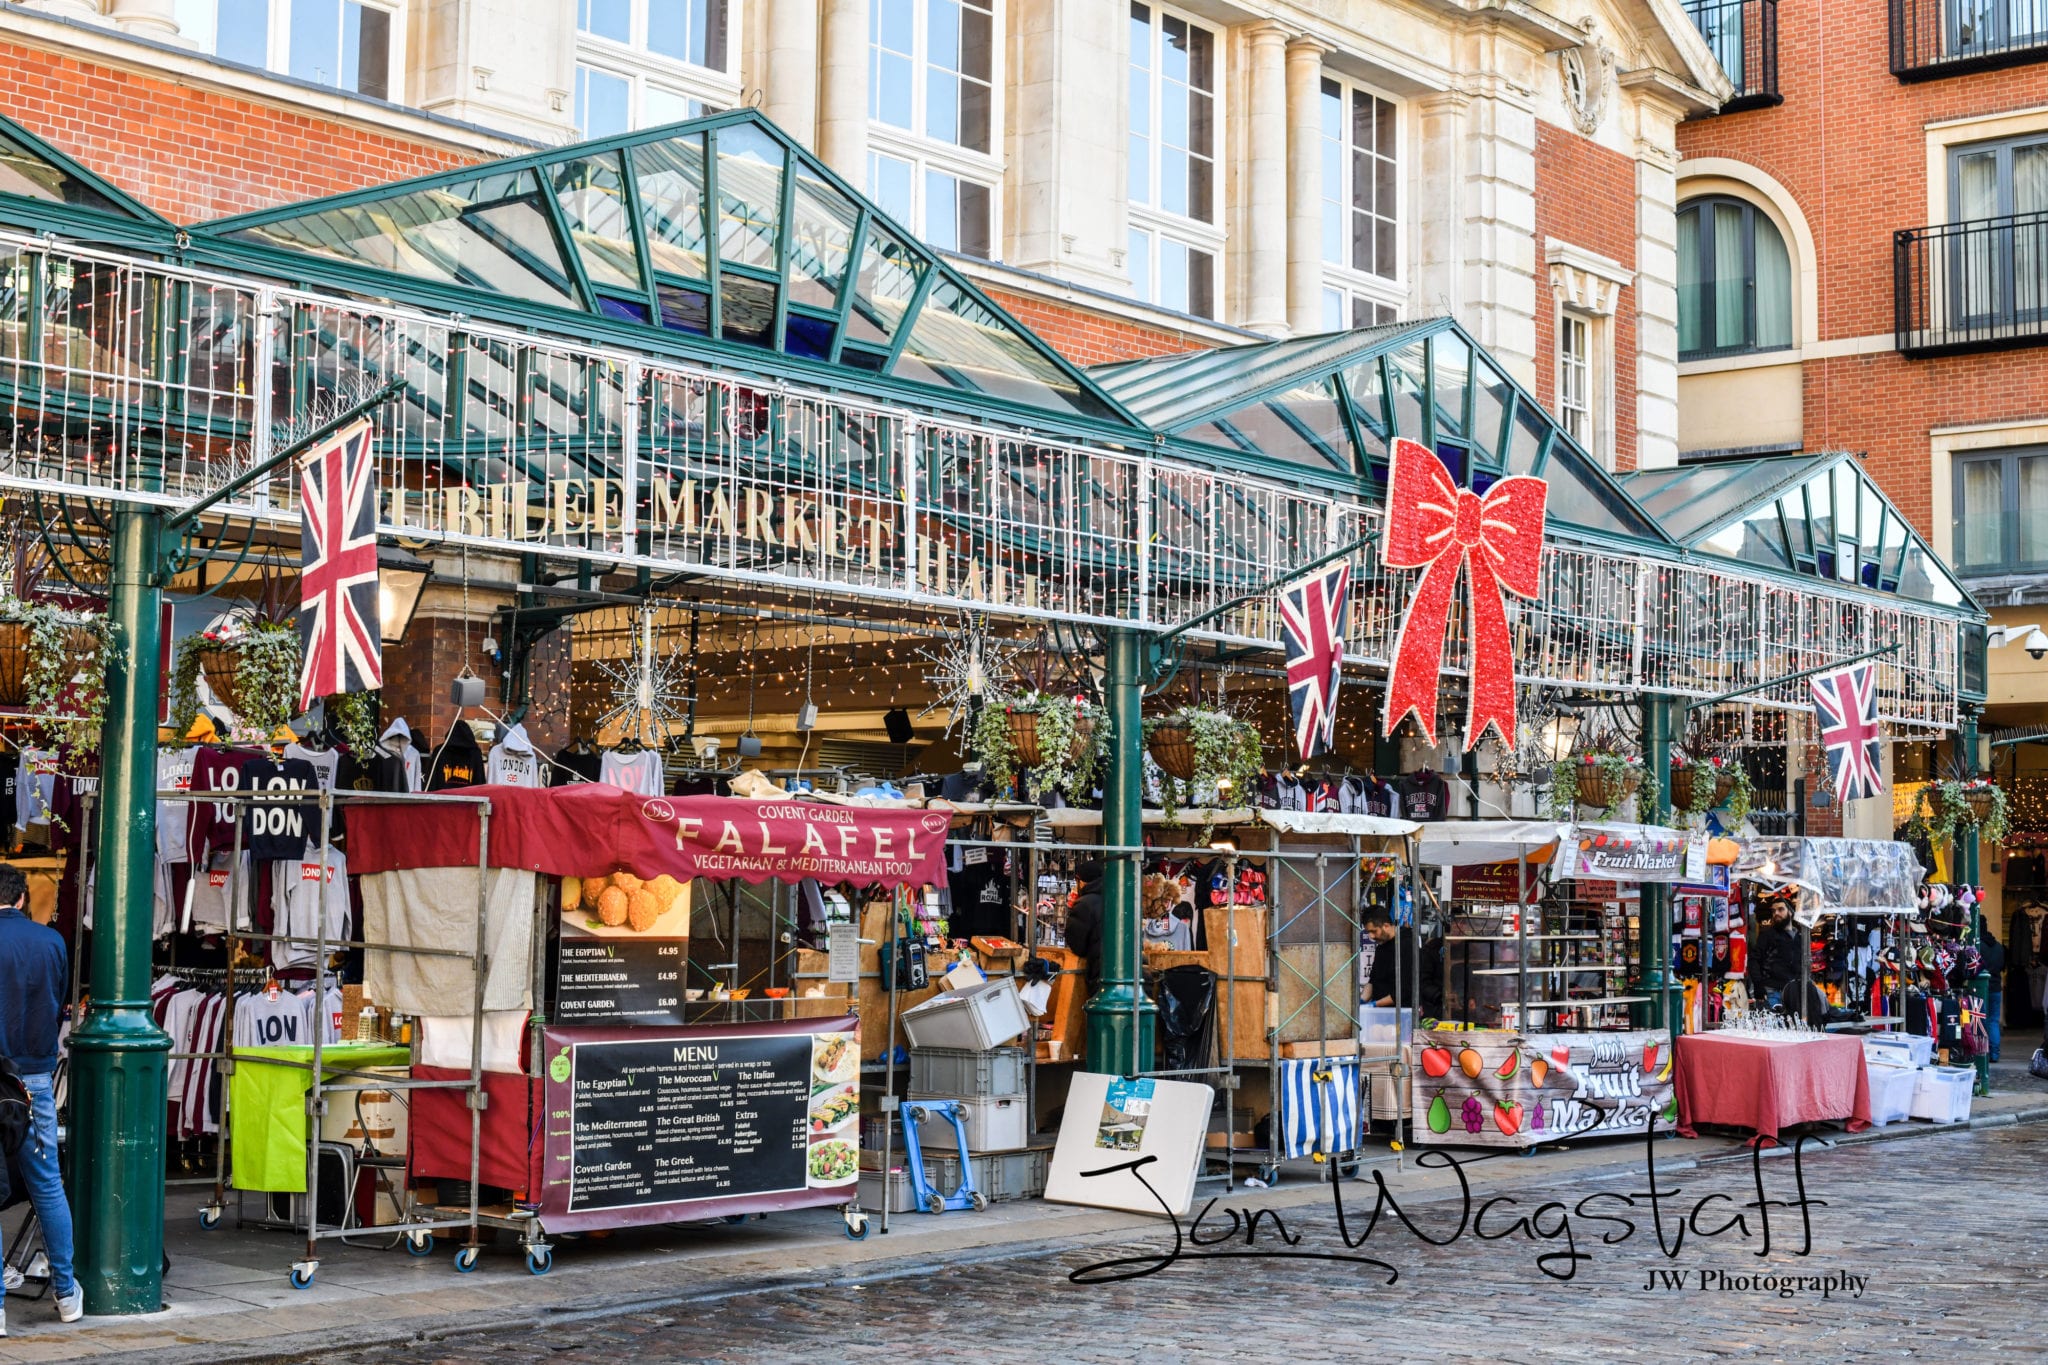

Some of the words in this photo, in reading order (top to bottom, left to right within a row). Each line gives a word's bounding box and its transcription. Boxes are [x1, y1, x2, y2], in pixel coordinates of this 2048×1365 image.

[653, 477, 892, 570] MARKET
[500, 758, 530, 775] LONDON
[252, 776, 307, 801] LON
[758, 805, 806, 820] COVENT
[809, 808, 854, 824] GARDEN
[253, 808, 303, 838] DON
[676, 817, 926, 861] FALAFEL
[693, 854, 773, 871] VEGETARIAN
[776, 858, 787, 871] &
[791, 857, 883, 876] MEDITERRANEAN
[886, 861, 912, 876] FOOD
[1593, 851, 1633, 869] Fruit
[1634, 853, 1677, 870] Market
[302, 867, 332, 880] LONDN
[561, 948, 575, 957] THE
[575, 948, 607, 957] EGYPTIAN
[658, 946, 679, 955] £4.95
[561, 974, 574, 983] THE
[574, 973, 628, 982] MEDITERRANEAN
[657, 972, 678, 980] £4.95
[560, 1000, 586, 1009] COVENT
[587, 1000, 615, 1008] GARDEN
[658, 998, 678, 1006] £6.00
[257, 1014, 297, 1044] LON
[674, 1045, 718, 1062] MENU
[629, 1066, 645, 1074] served
[656, 1064, 677, 1072] hummus
[738, 1071, 752, 1080] The
[753, 1070, 775, 1080] Italian
[576, 1080, 591, 1090] The
[592, 1078, 627, 1090] Egyptian
[658, 1075, 673, 1085] The
[674, 1074, 712, 1084] Moroccan
[1571, 1062, 1642, 1100] Fruit
[552, 1110, 571, 1119] 100%
[639, 1105, 654, 1113] £4.95
[735, 1111, 758, 1120] Extras
[657, 1117, 671, 1126] The
[672, 1115, 694, 1125] Great
[696, 1113, 720, 1123] British
[1551, 1098, 1662, 1134] Market
[576, 1123, 590, 1132] The
[591, 1119, 647, 1131] Mediterranean
[575, 1164, 603, 1174] Covent
[604, 1161, 632, 1172] Garden
[655, 1158, 670, 1167] The
[671, 1156, 694, 1166] Greek
